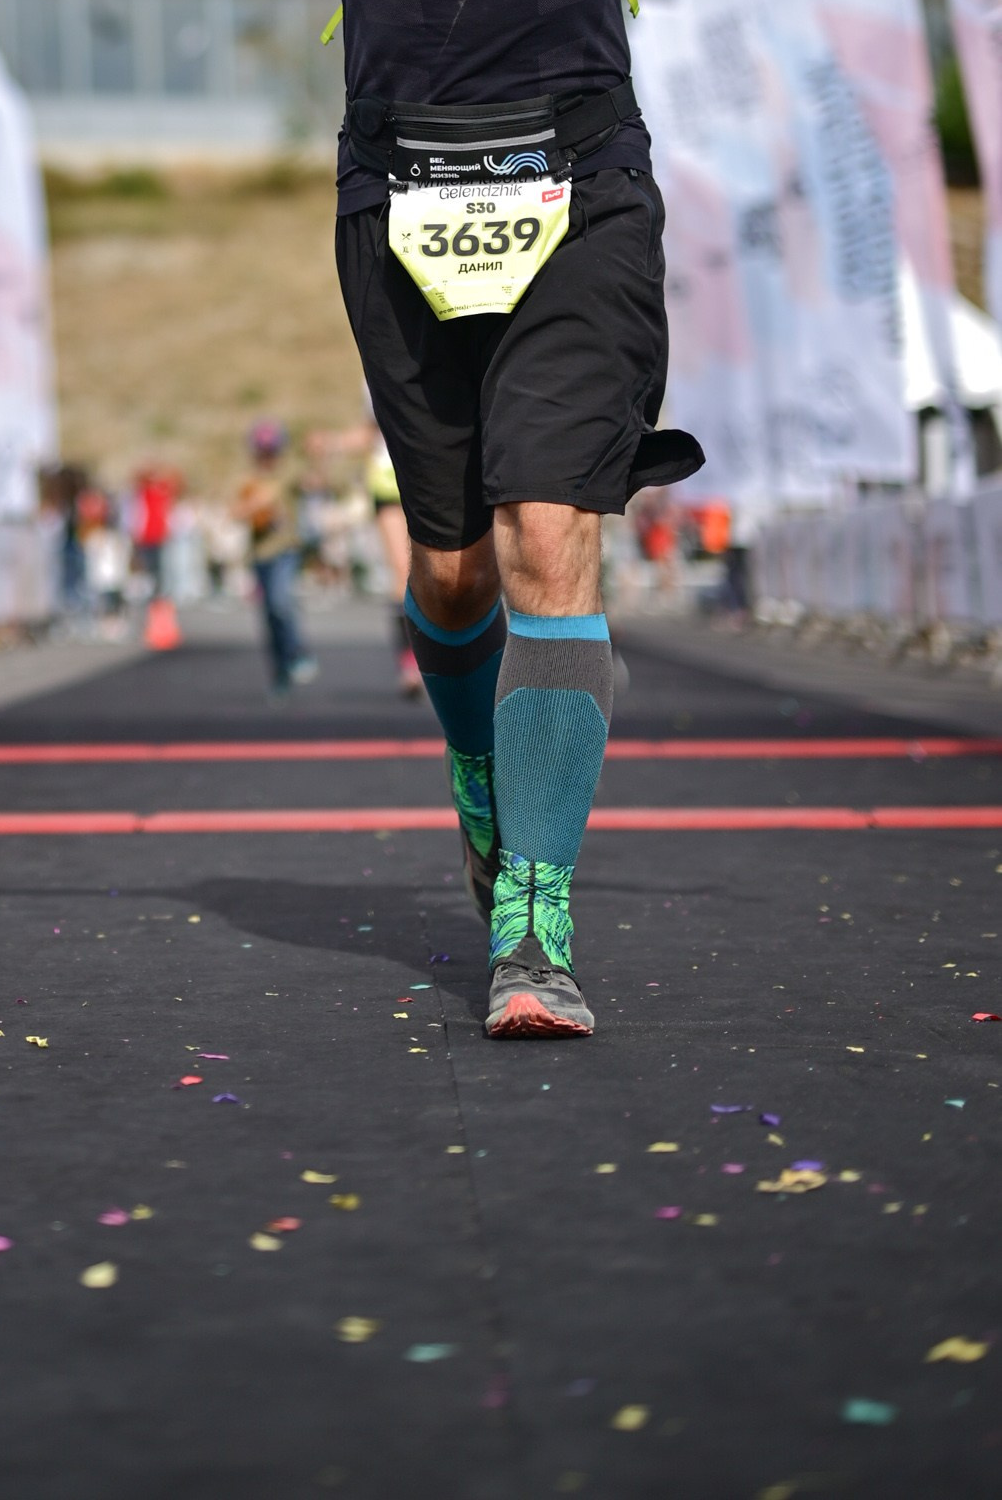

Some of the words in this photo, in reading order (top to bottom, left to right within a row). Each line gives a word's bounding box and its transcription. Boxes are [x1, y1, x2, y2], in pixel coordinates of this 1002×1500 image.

[429, 157, 445, 165] БЕГ,
[429, 163, 481, 172] МЕНЯЮЩИЙ
[430, 172, 460, 180] ЖИЗНЬ
[439, 184, 523, 200] Gelendzhik
[466, 202, 496, 214] S30
[420, 217, 542, 258] 3639
[458, 261, 503, 274] ДАНИЛ
